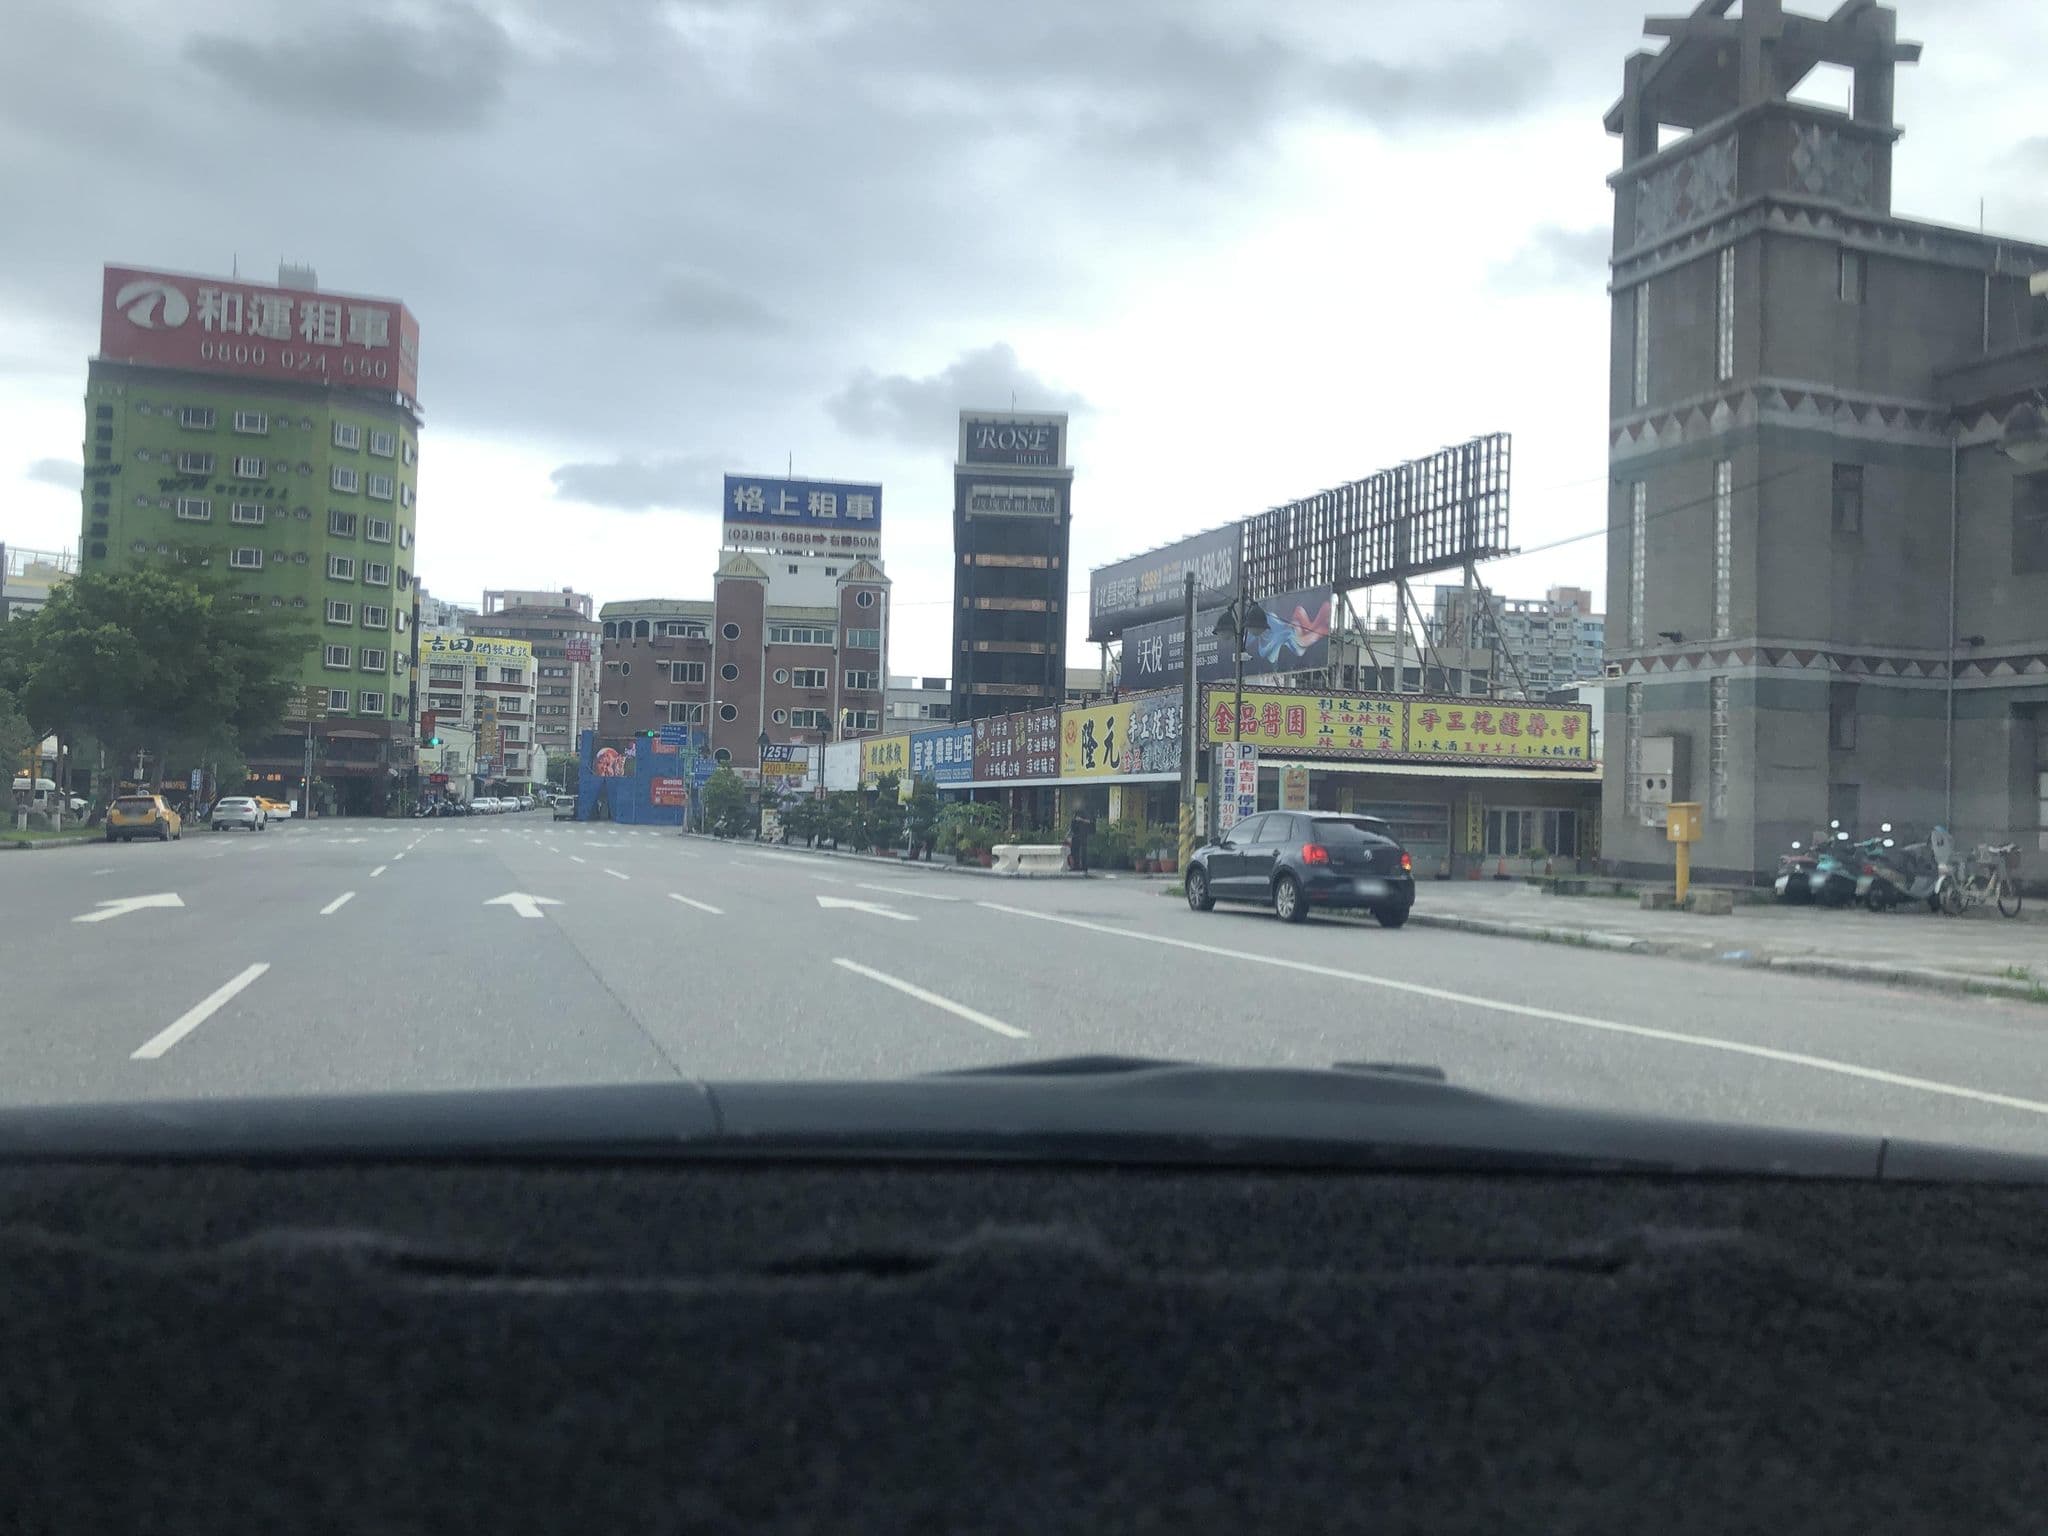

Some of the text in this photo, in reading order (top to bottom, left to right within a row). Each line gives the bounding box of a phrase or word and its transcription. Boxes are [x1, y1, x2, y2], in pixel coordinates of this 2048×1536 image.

[196, 286, 390, 350] 和運租車
[201, 340, 266, 366] 0800
[976, 426, 1049, 451] ROSE
[733, 485, 874, 520] 格上租車
[1140, 635, 1163, 674] 天悅
[1242, 745, 1252, 758] P
